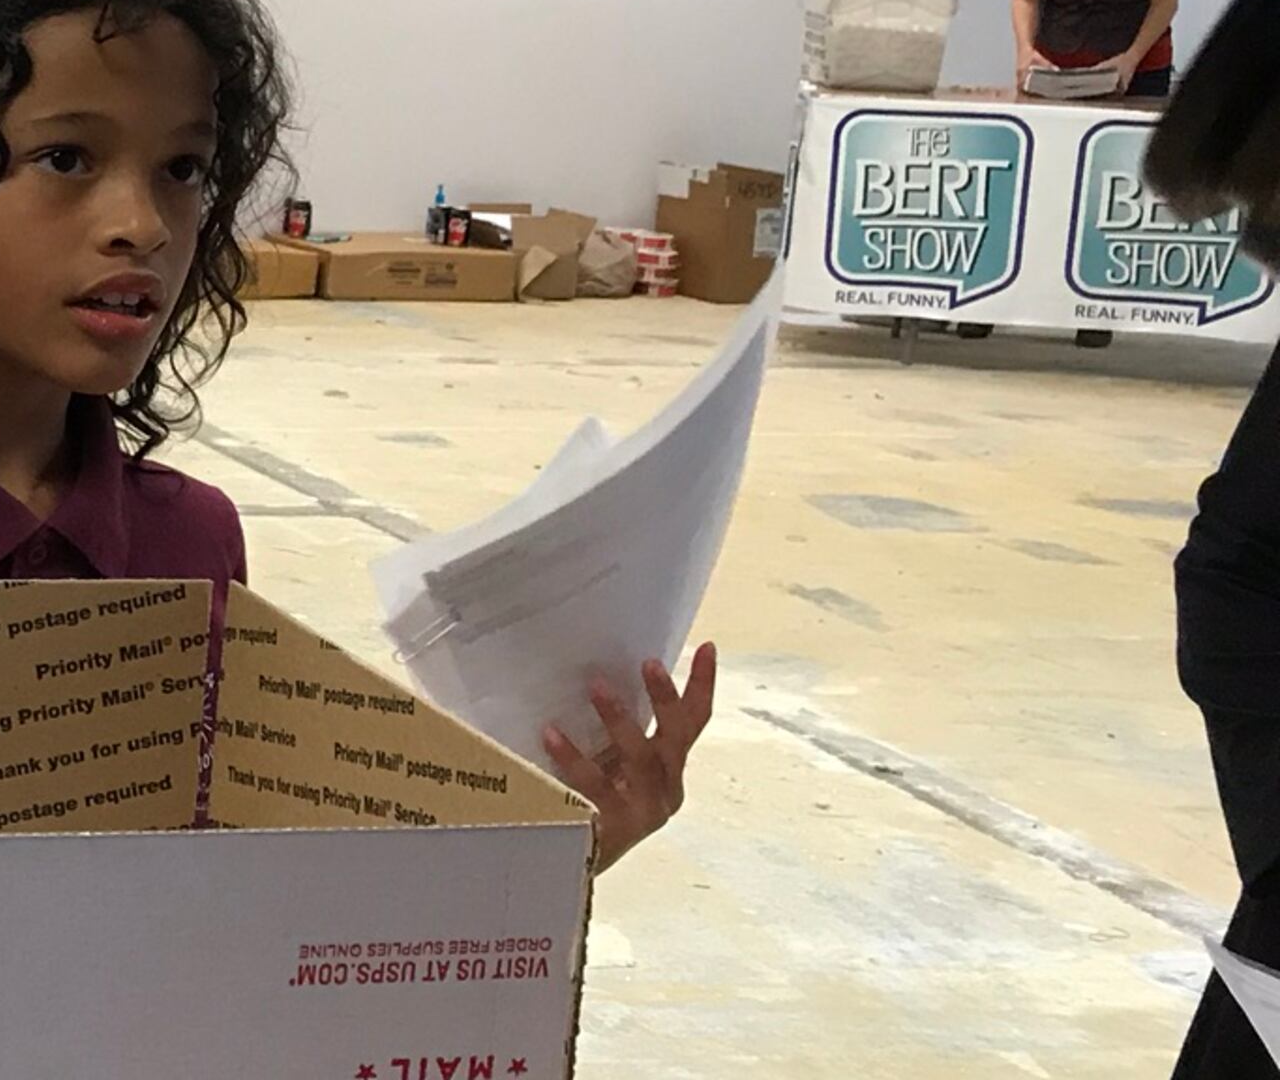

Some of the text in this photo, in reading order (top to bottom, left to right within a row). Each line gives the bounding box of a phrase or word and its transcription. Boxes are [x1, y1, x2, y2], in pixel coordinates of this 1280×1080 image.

[852, 159, 1012, 218] BERT
[863, 225, 987, 275] SHOW
[1105, 239, 1238, 289] SHOW
[835, 290, 947, 309] REAL. FUNNY.
[1075, 304, 1124, 320] REAL.
[8, 607, 91, 639] postage
[98, 584, 186, 616] required
[35, 653, 113, 680] Priority
[239, 627, 277, 646] required
[18, 697, 95, 726] Priority
[259, 674, 293, 699] Priority
[324, 688, 365, 710] postage
[368, 693, 416, 717] required
[47, 749, 85, 772] you
[91, 741, 122, 761] for
[127, 728, 183, 753] using
[261, 724, 296, 748] Service
[334, 742, 373, 770] Priority
[406, 759, 453, 784] postage
[456, 769, 507, 794] required
[85, 775, 173, 807] required
[228, 765, 256, 788] Thank
[257, 773, 275, 793] you
[276, 777, 291, 796] for
[293, 782, 320, 806] using
[323, 787, 361, 815] Priority
[394, 803, 437, 826] Service
[298, 937, 552, 959] ORDER FREE SUPPLIES ONLINE
[422, 960, 450, 982] AT
[456, 959, 486, 981] US
[492, 957, 549, 979] VISIT
[391, 1055, 494, 1080] MAIL
